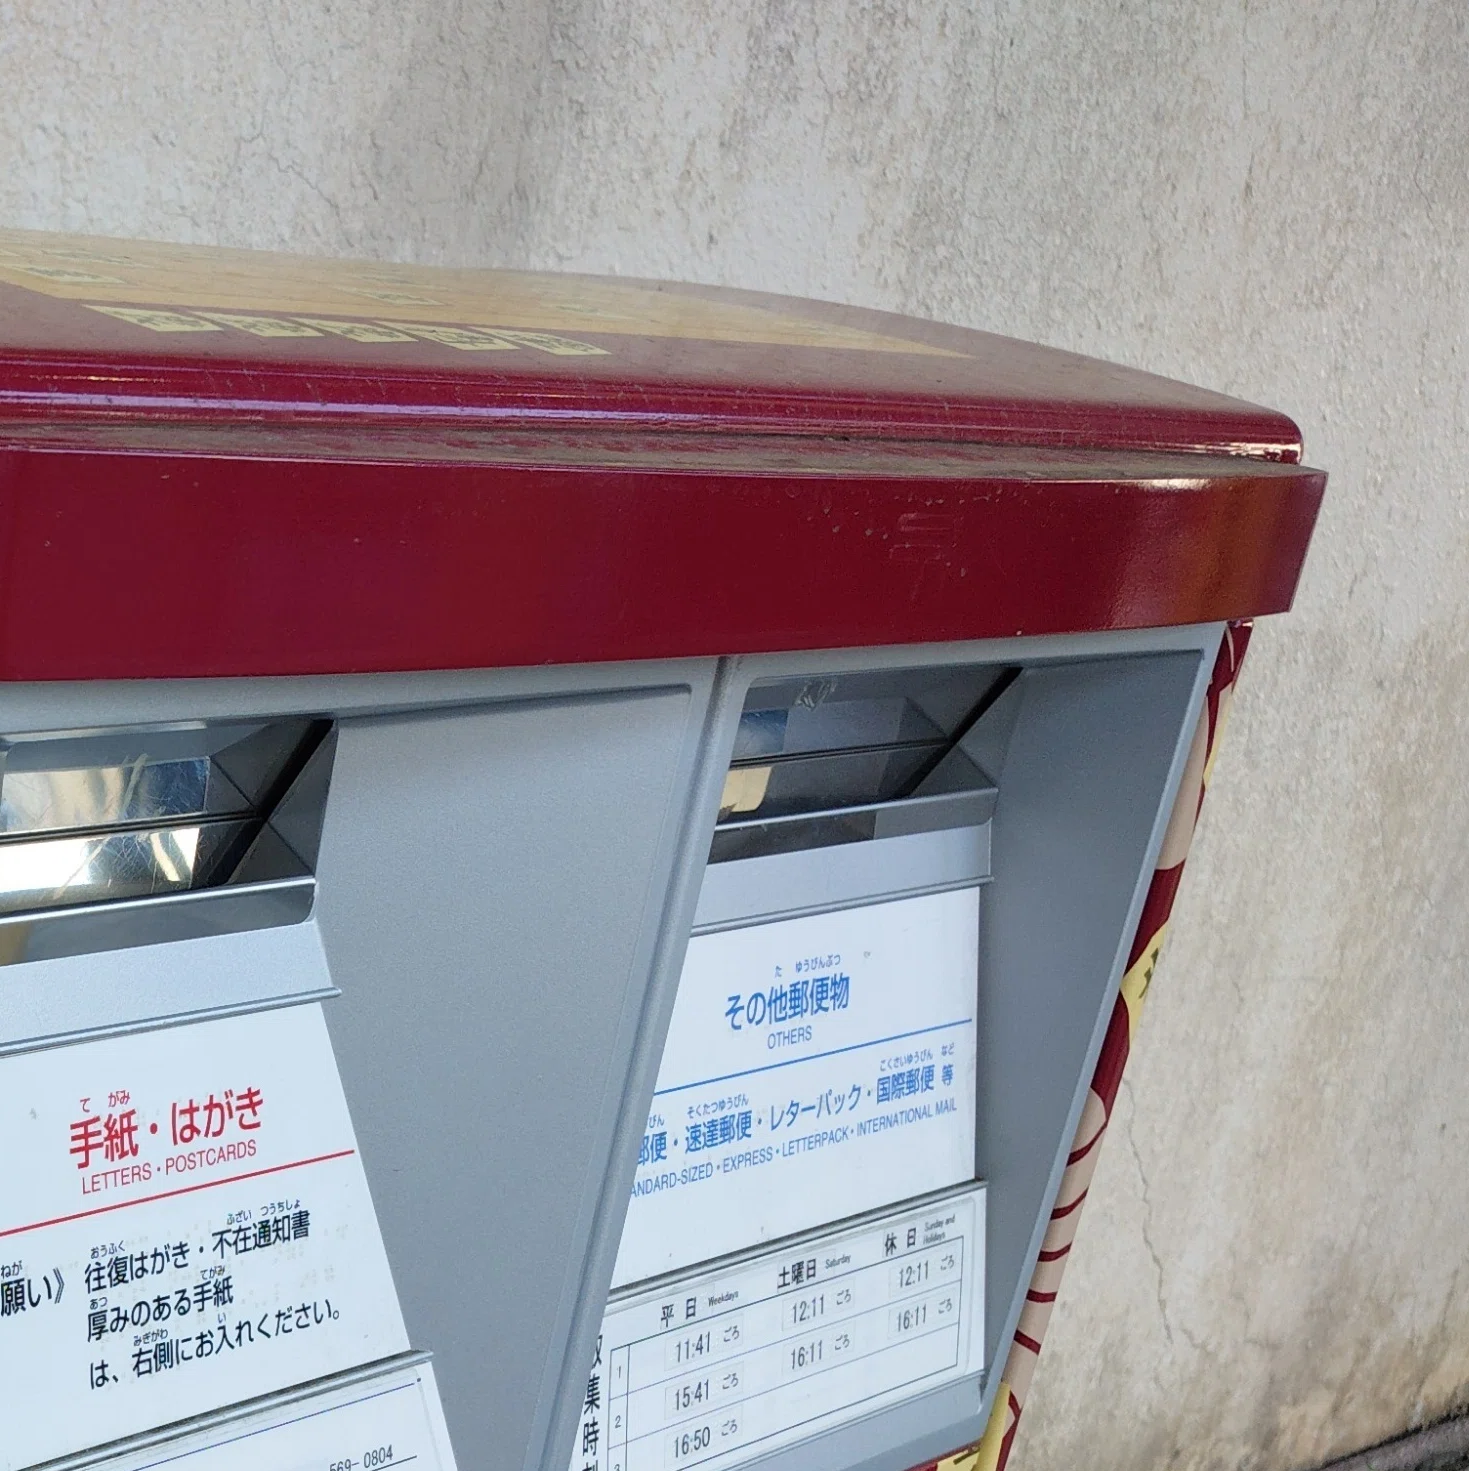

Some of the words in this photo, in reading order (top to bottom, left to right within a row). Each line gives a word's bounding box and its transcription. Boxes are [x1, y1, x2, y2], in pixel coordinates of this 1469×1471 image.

[795, 954, 841, 973] ゆうびんぶつ
[725, 972, 850, 1030] その他郵便物
[767, 1025, 812, 1050] OTHERS
[80, 1097, 91, 1113] て
[108, 1090, 130, 1107] がみ
[941, 1064, 954, 1087] 等
[70, 1087, 263, 1169] 手紙・はがき
[723, 1146, 773, 1174] EXPRESS
[782, 1126, 849, 1157] LETTERPACK
[856, 1103, 934, 1137] INTERNATIONAL
[935, 1097, 958, 1115] MAIL
[0, 1260, 23, 1279] ねが
[90, 1240, 126, 1259] おうふく
[226, 1209, 252, 1225] ふざい
[260, 1199, 301, 1215] つうちしょ
[85, 1210, 311, 1294] 往復はがき・不在通知書
[87, 1275, 233, 1343] 厚みのある手紙
[89, 1297, 108, 1311] あつ
[200, 1264, 226, 1280] てがみ
[660, 1297, 697, 1329] 平日
[777, 1258, 816, 1289] 土曜日
[884, 1227, 917, 1257] 休日
[708, 1290, 739, 1307] Weekdays
[133, 1328, 168, 1347] みぎがわ
[217, 1313, 226, 1324] い
[675, 1331, 711, 1363] 11:41
[723, 1324, 740, 1343] ごろ
[792, 1294, 824, 1324] 12:11
[836, 1288, 851, 1305] ごろ
[899, 1260, 929, 1288] 12:11
[89, 1300, 340, 1390] は、右側にお入れください。
[674, 1379, 710, 1411] 15:41
[722, 1372, 739, 1390] ごろ
[791, 1340, 823, 1370] 16:11
[834, 1334, 850, 1351] ごろ
[898, 1304, 927, 1332] 16:11
[673, 1426, 711, 1459] 16:50
